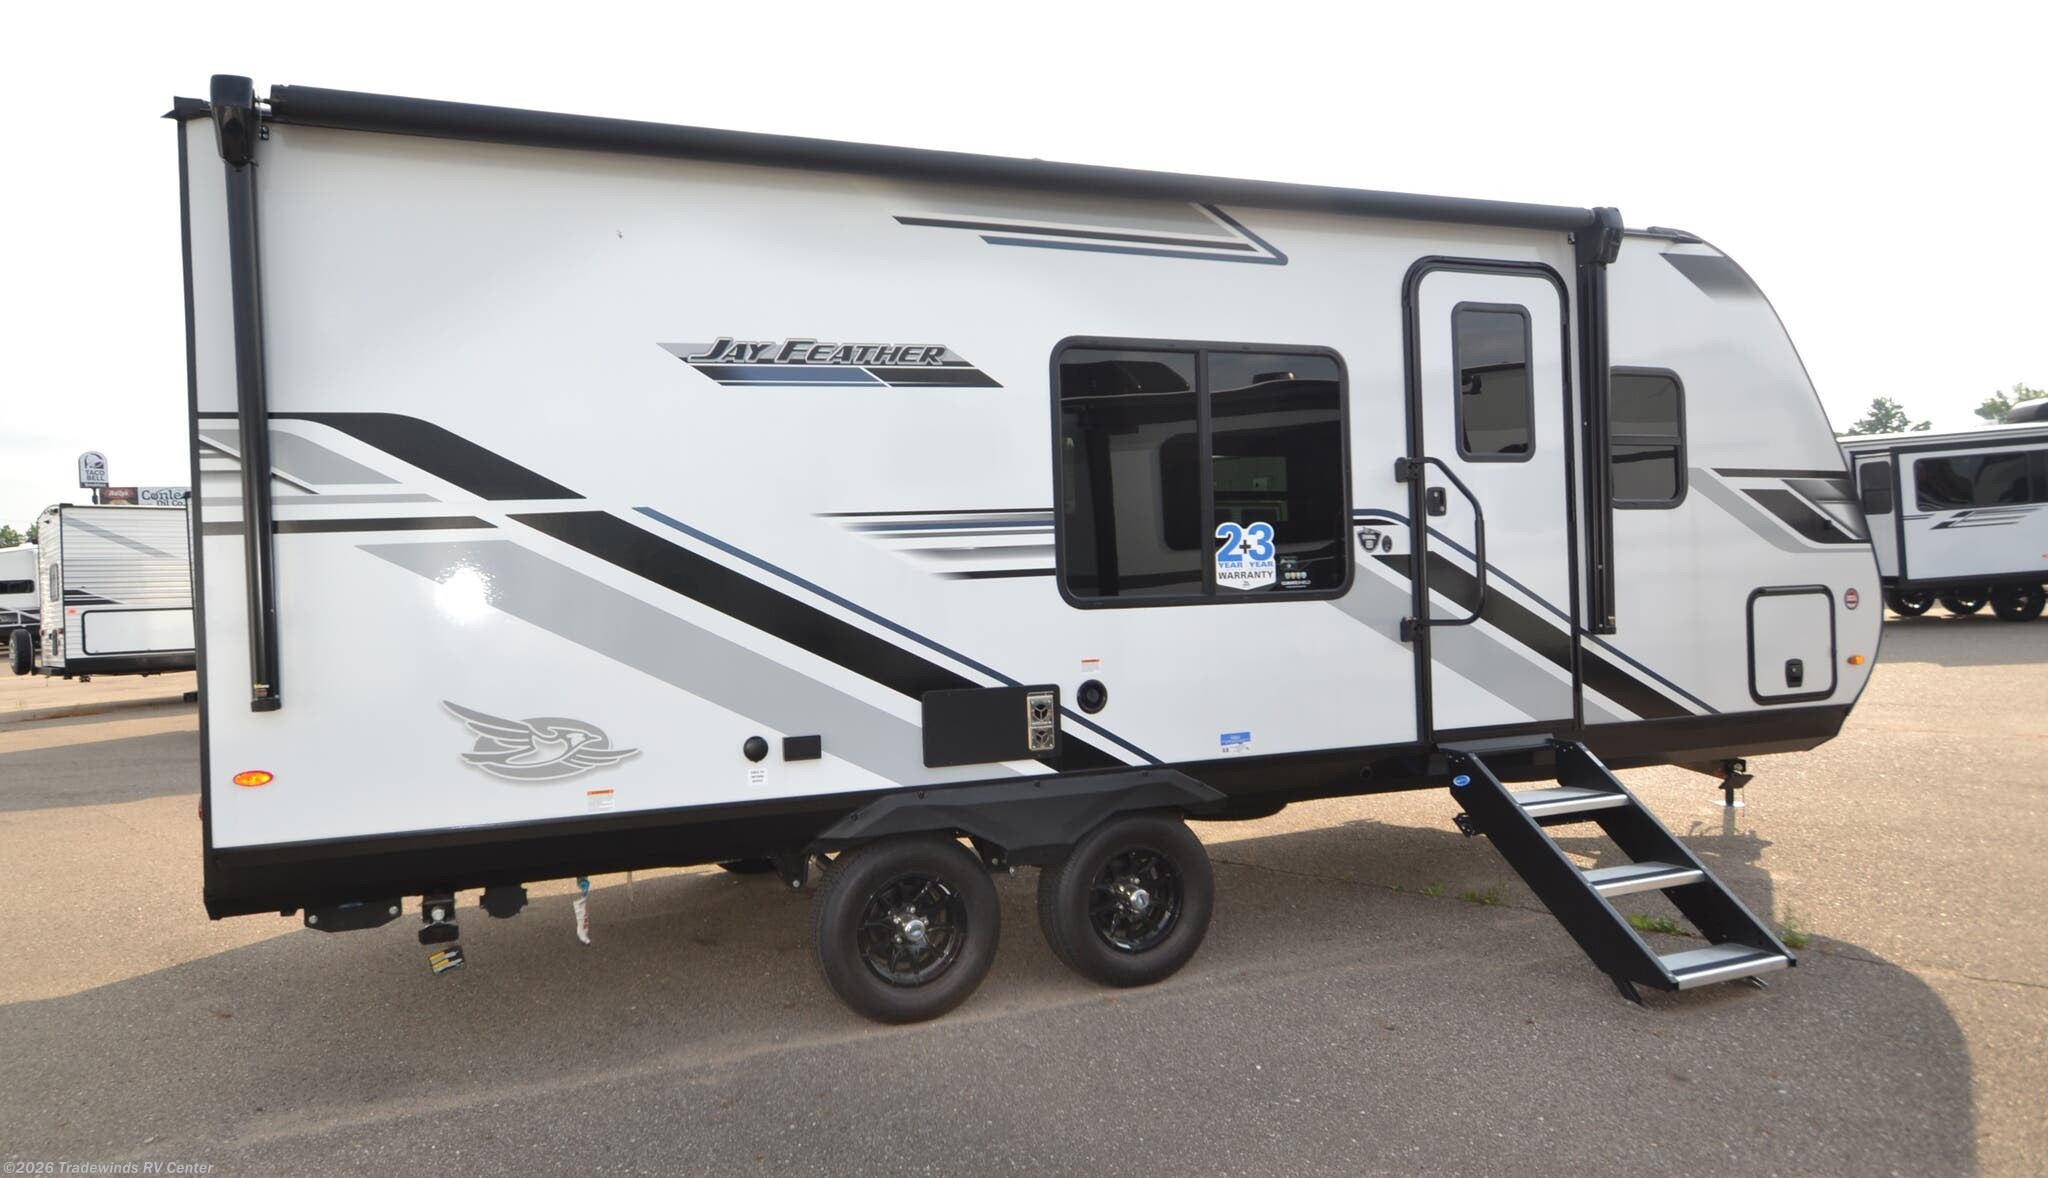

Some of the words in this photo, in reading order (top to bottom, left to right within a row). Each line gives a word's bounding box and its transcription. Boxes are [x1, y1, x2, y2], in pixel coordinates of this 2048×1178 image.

[687, 337, 777, 364] JAY
[774, 338, 949, 365] FEATHER
[141, 489, 186, 500] Conle
[1218, 561, 1243, 569] YEAR
[1248, 560, 1274, 568] YEAR
[1218, 570, 1274, 580] WARRANTY
